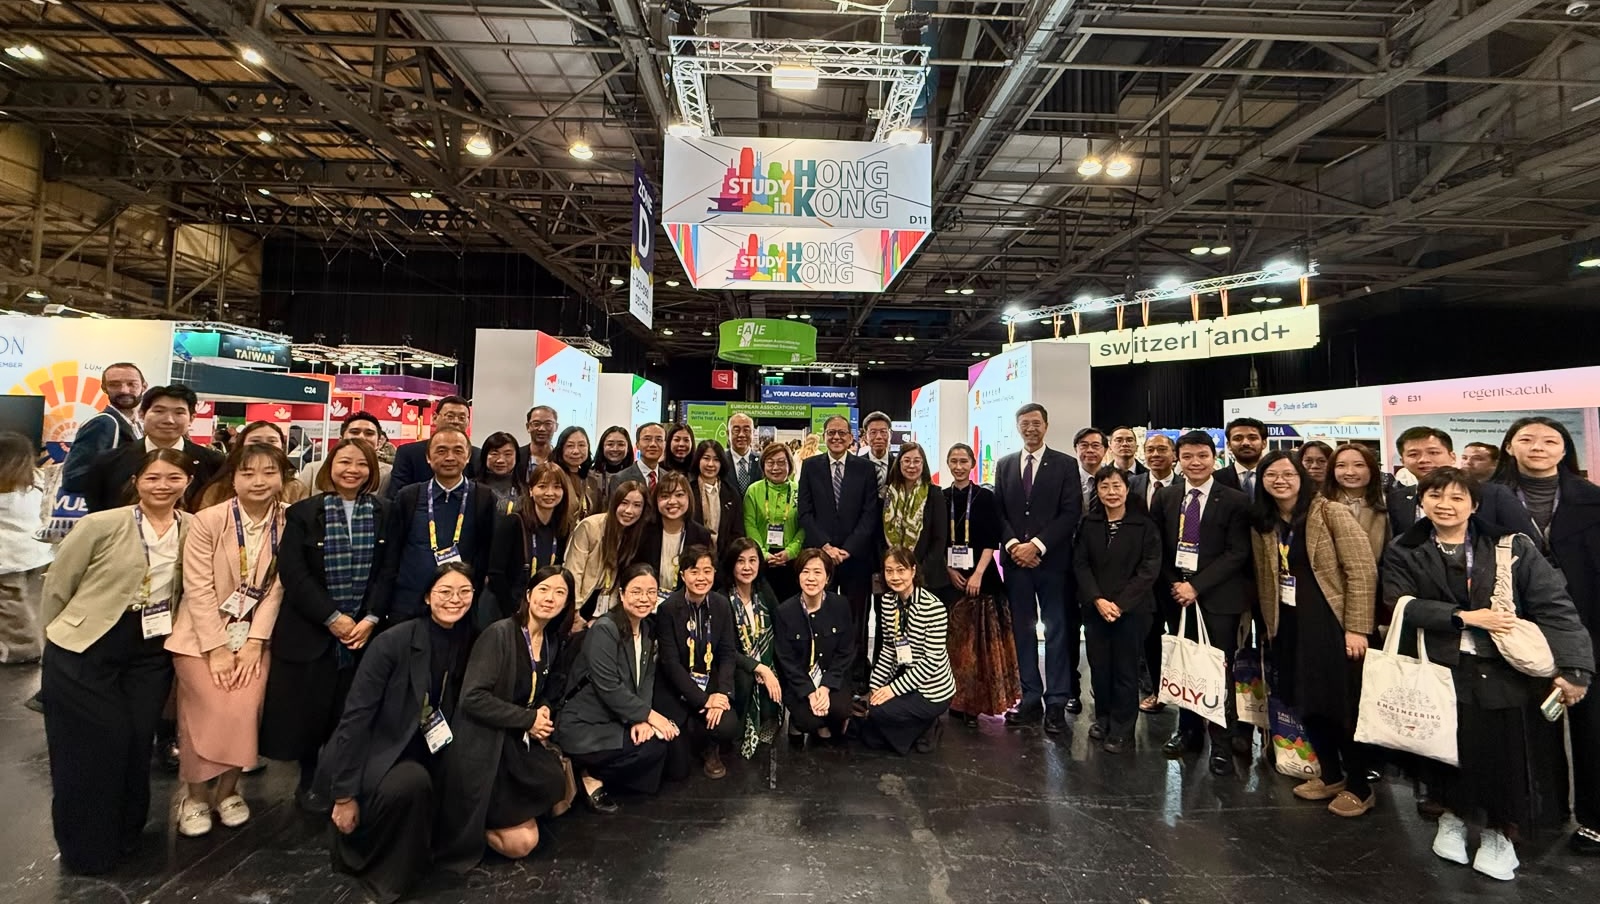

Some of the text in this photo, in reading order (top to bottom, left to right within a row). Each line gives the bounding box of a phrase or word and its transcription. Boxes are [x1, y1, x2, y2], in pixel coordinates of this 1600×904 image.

[794, 159, 888, 189] HONG
[729, 178, 791, 195] STUDY
[773, 197, 791, 214] in
[794, 188, 888, 218] KONG
[909, 215, 927, 225] D11
[638, 203, 650, 259] D
[786, 242, 853, 263] HONG
[740, 255, 785, 269] STUDY
[772, 270, 785, 282] in
[786, 262, 853, 283] KONG
[736, 324, 767, 336] EAIE
[234, 348, 275, 364] TAIWAN
[84, 363, 102, 371] LUM
[304, 386, 317, 394] C24
[1408, 383, 1554, 403] E31 regents.ac.uk
[1302, 401, 1318, 409] Serbia
[1267, 426, 1285, 435] DIA
[1329, 425, 1359, 435] INDIA
[1161, 676, 1219, 709] POLYU
[1377, 701, 1441, 721] ENGINEERING
